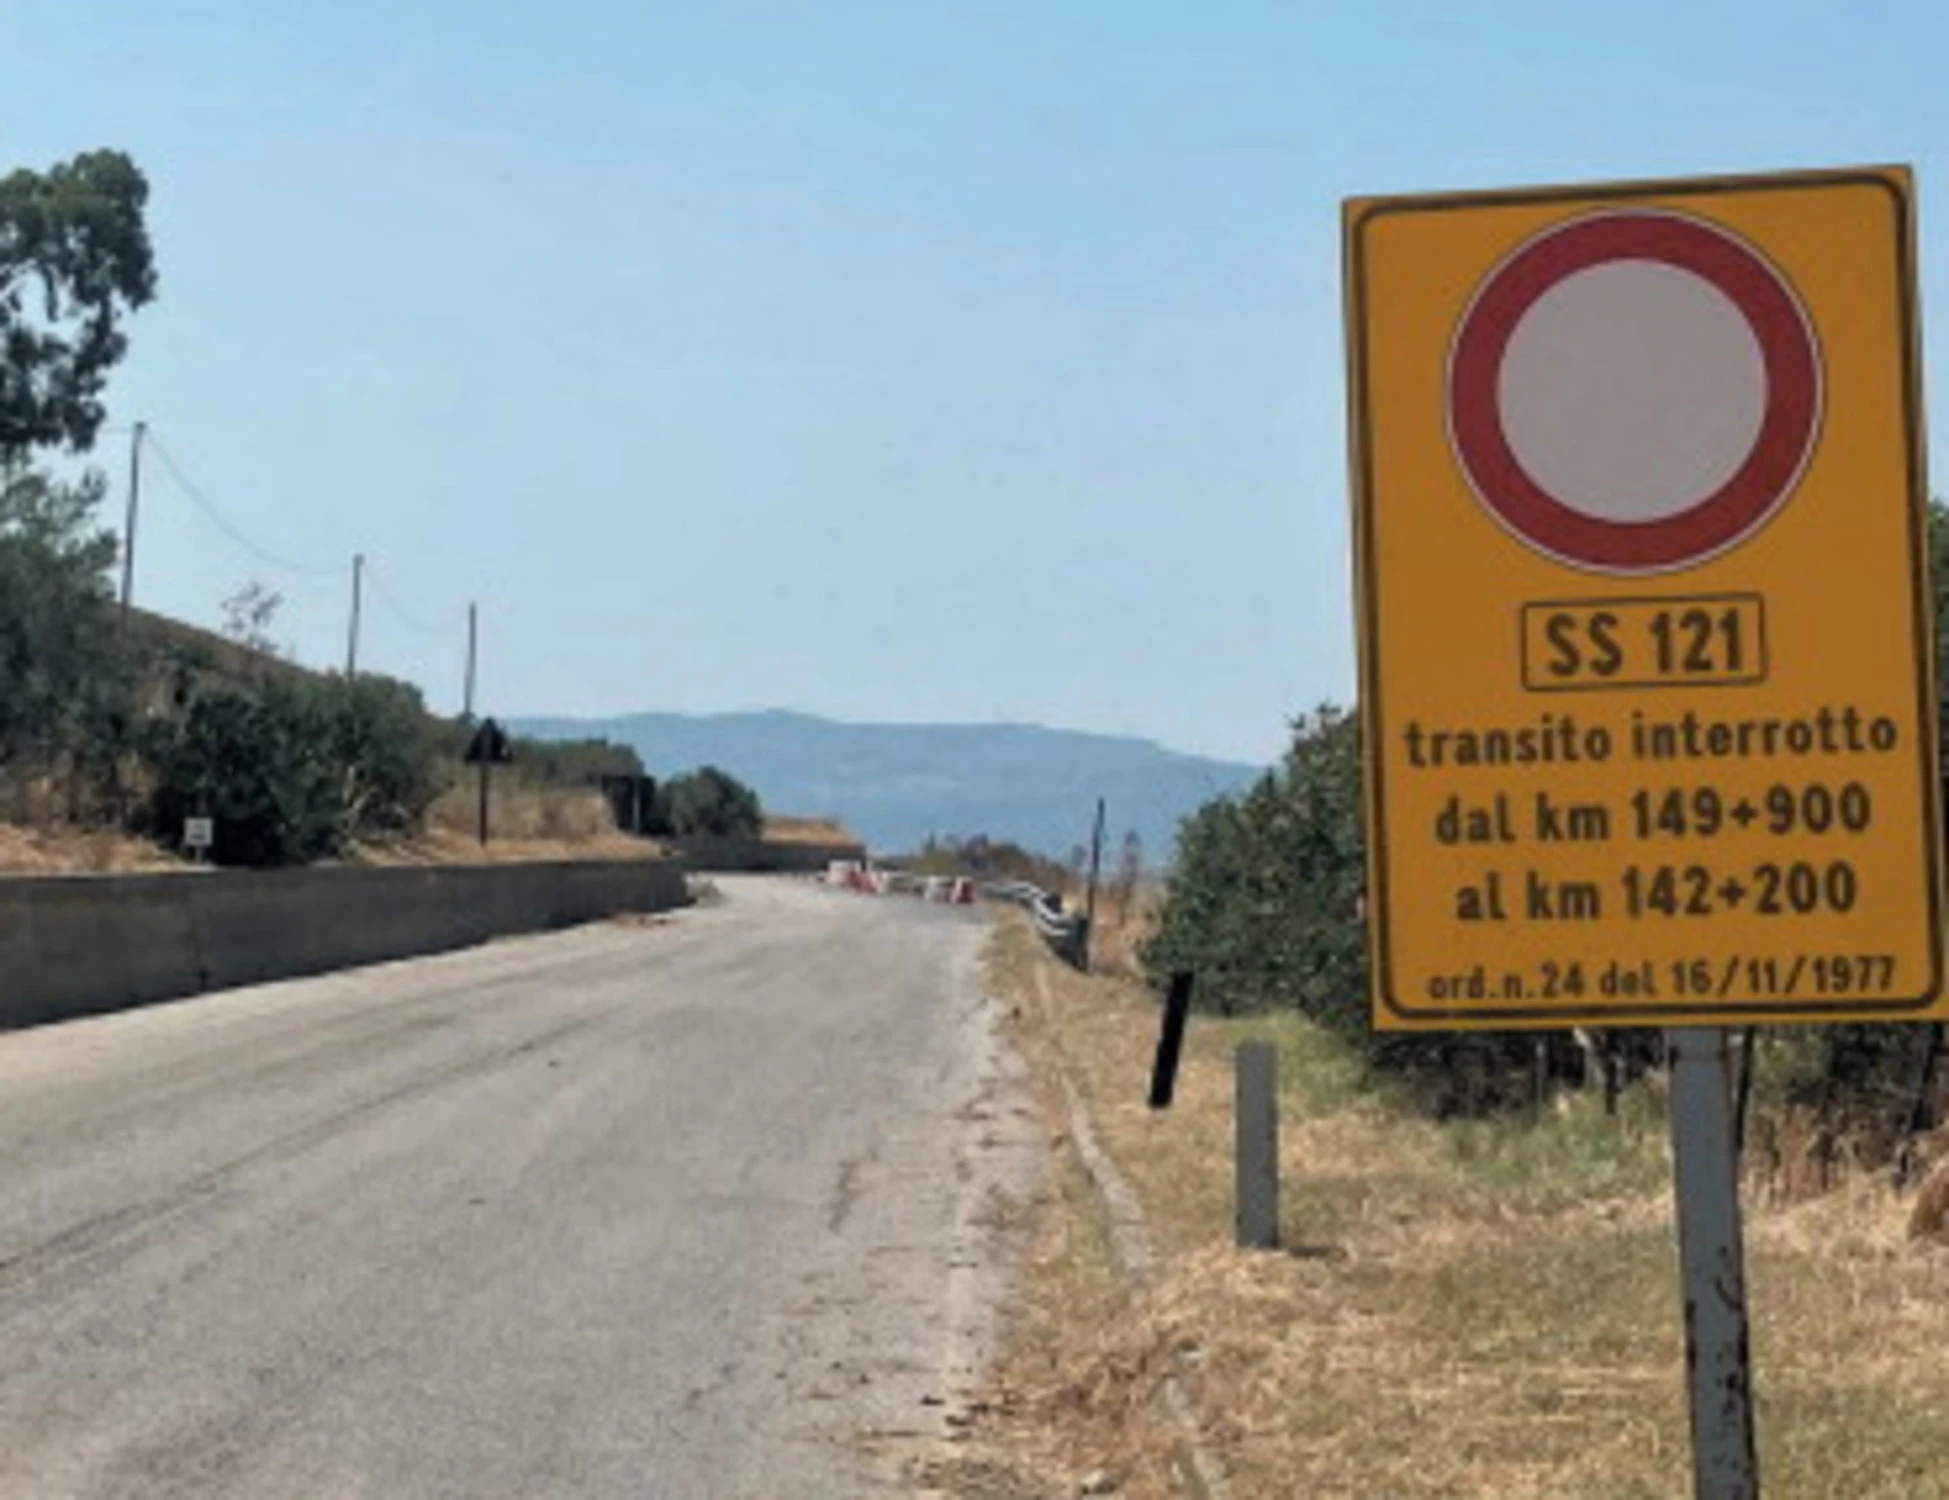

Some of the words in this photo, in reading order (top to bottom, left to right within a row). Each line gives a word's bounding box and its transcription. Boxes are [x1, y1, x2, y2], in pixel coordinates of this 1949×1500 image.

[1545, 612, 1623, 677] SS
[1648, 608, 1744, 675] 121
[1404, 714, 1612, 767] transito
[1631, 706, 1898, 759] interrotto
[1435, 795, 1516, 845] dal
[1536, 793, 1610, 842] km
[1631, 783, 1872, 838] 149+900
[1455, 872, 1506, 922] al
[1526, 871, 1601, 919] km
[1621, 861, 1857, 917] 142+200
[1600, 962, 1656, 998] del
